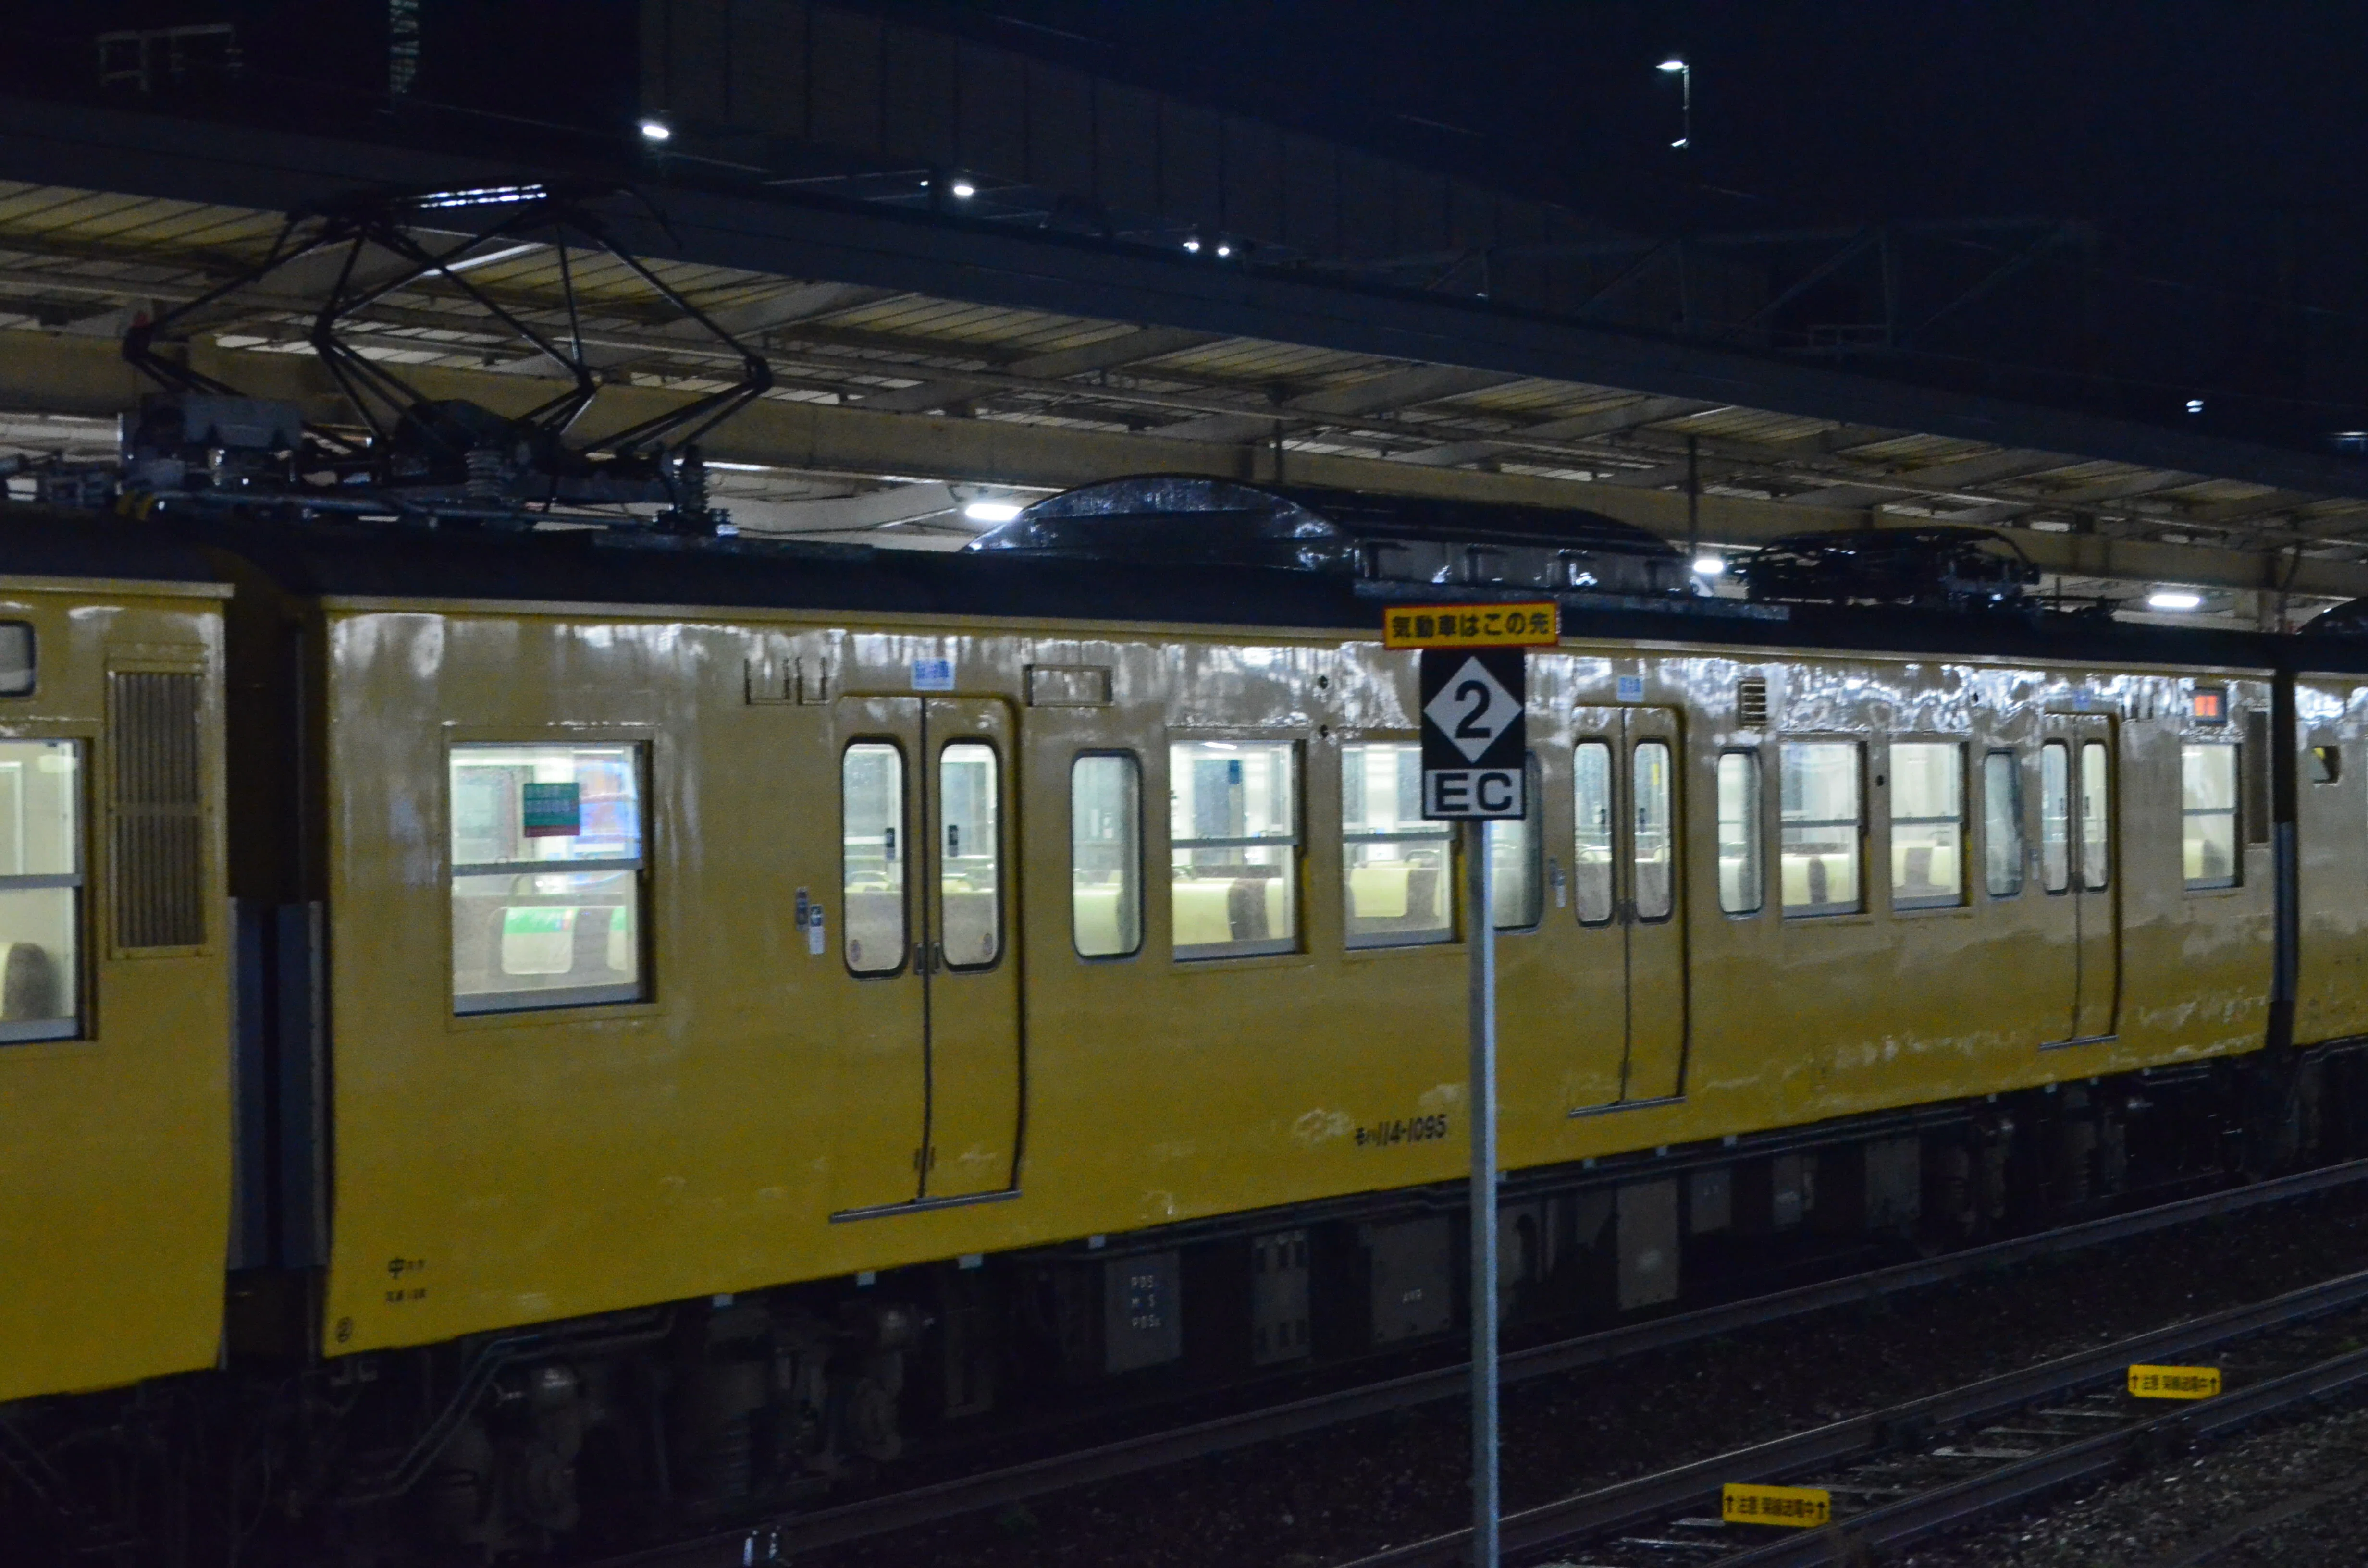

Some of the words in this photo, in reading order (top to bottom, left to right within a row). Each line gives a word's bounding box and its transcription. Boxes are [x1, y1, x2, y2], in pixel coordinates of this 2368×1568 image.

[1392, 612, 1549, 638] 気動車はこの先
[1454, 680, 1491, 738] 2
[1435, 772, 1512, 812] EC
